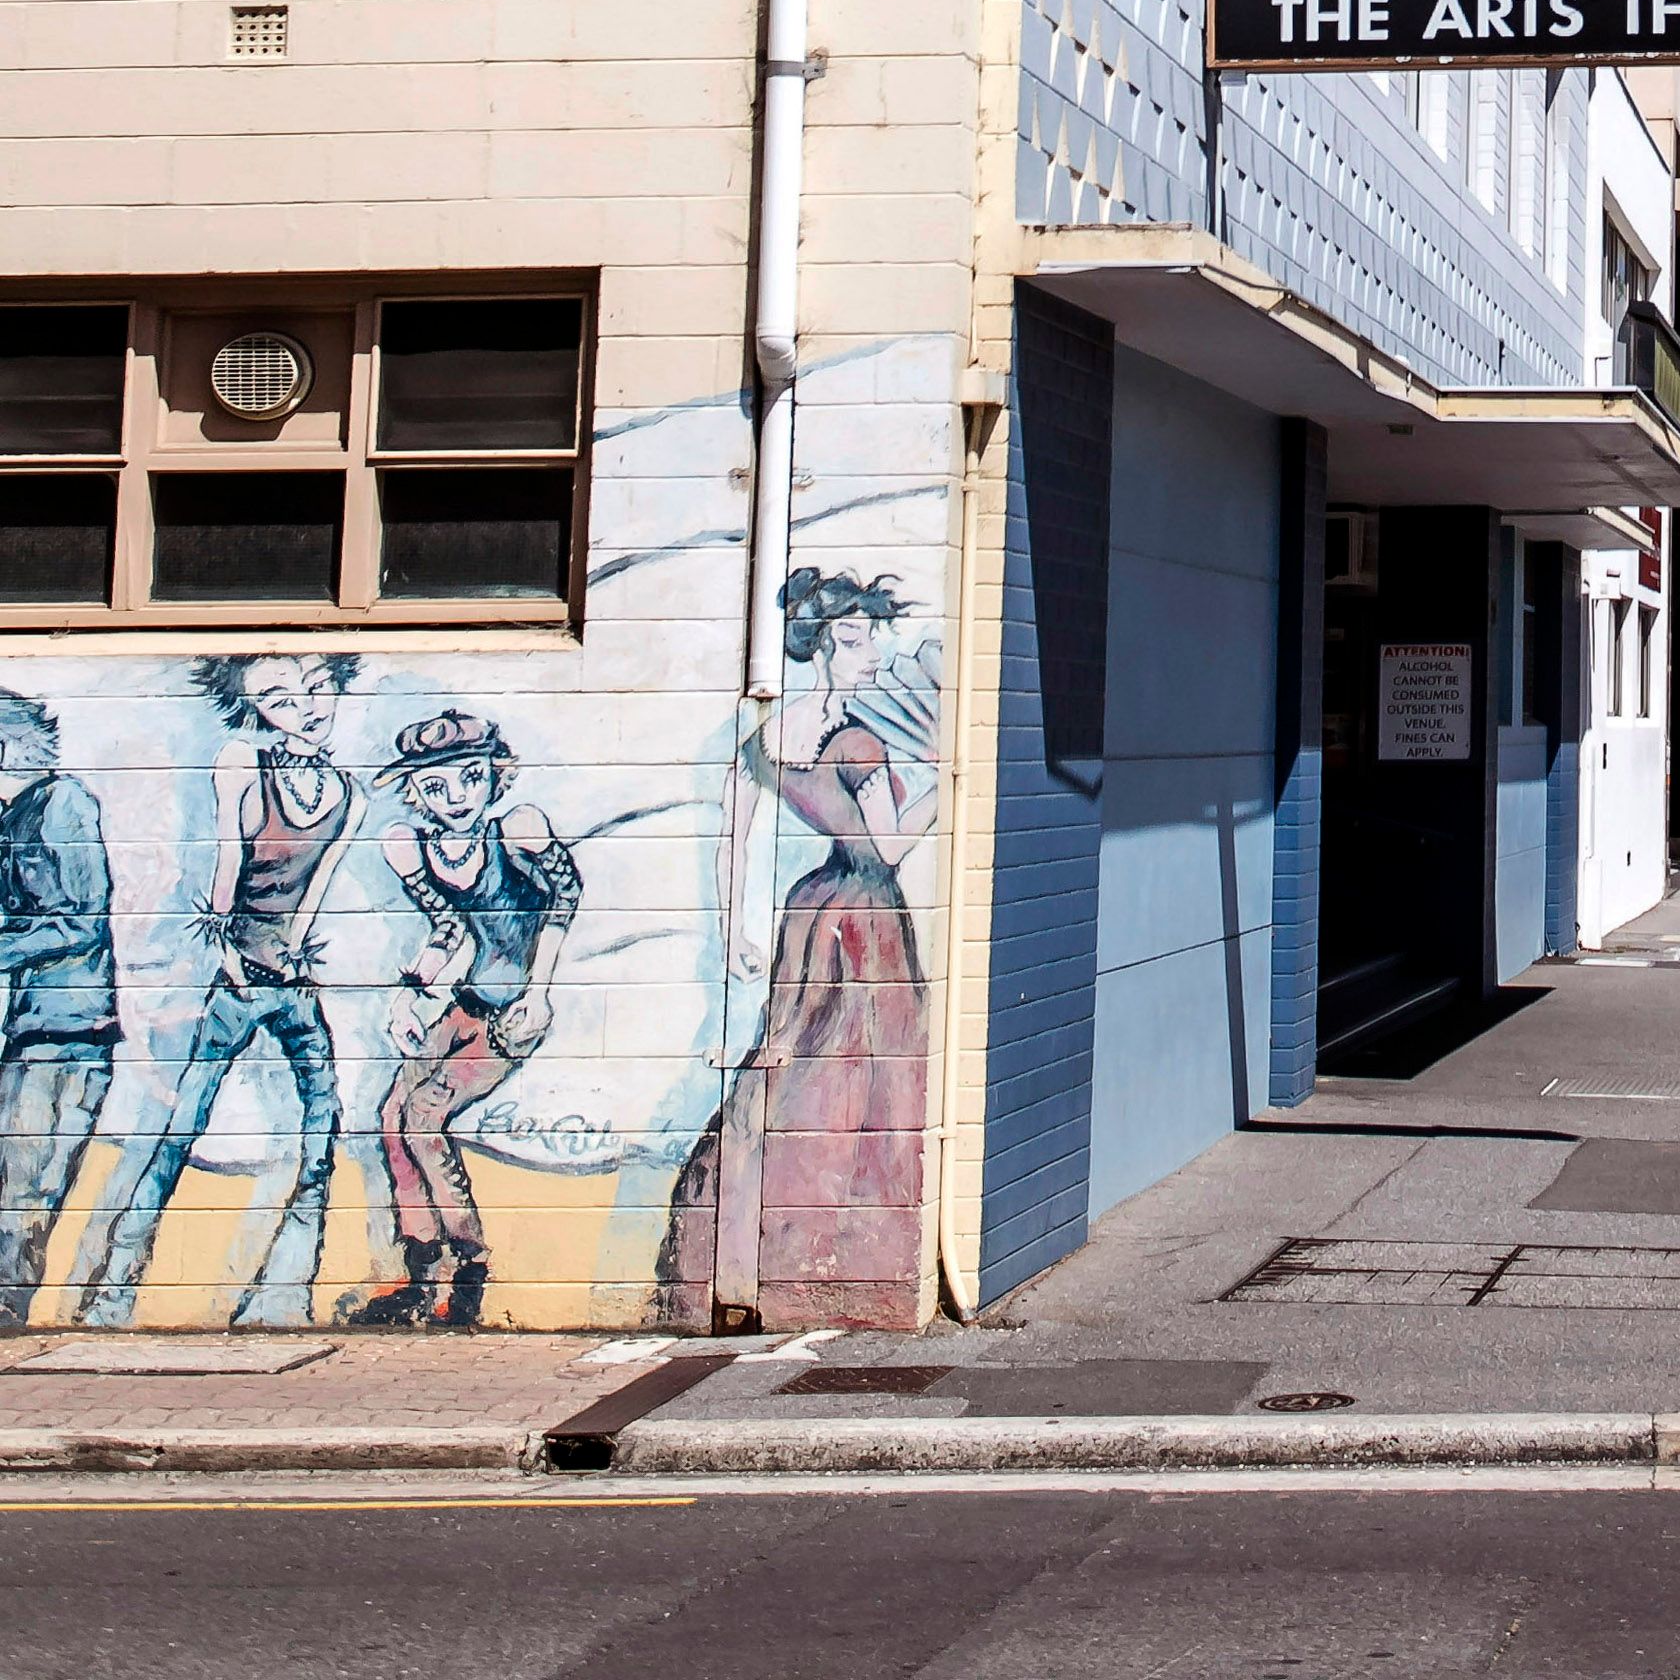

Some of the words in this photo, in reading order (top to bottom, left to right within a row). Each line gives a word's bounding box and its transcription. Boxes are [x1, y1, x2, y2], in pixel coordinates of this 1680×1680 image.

[1384, 646, 1469, 657] ATTENTION!
[1399, 662, 1454, 672] ALCOHOL
[1393, 676, 1442, 686] CANNOT
[1445, 676, 1459, 686] BE
[1392, 690, 1460, 700] CONSUMED
[1387, 705, 1437, 715] OUTSIDE
[1440, 704, 1464, 715] THIS
[1404, 719, 1446, 729] VENUE.
[1395, 733, 1427, 744] FINES
[1429, 733, 1455, 743] CAN
[1406, 747, 1443, 758] APPLY.
